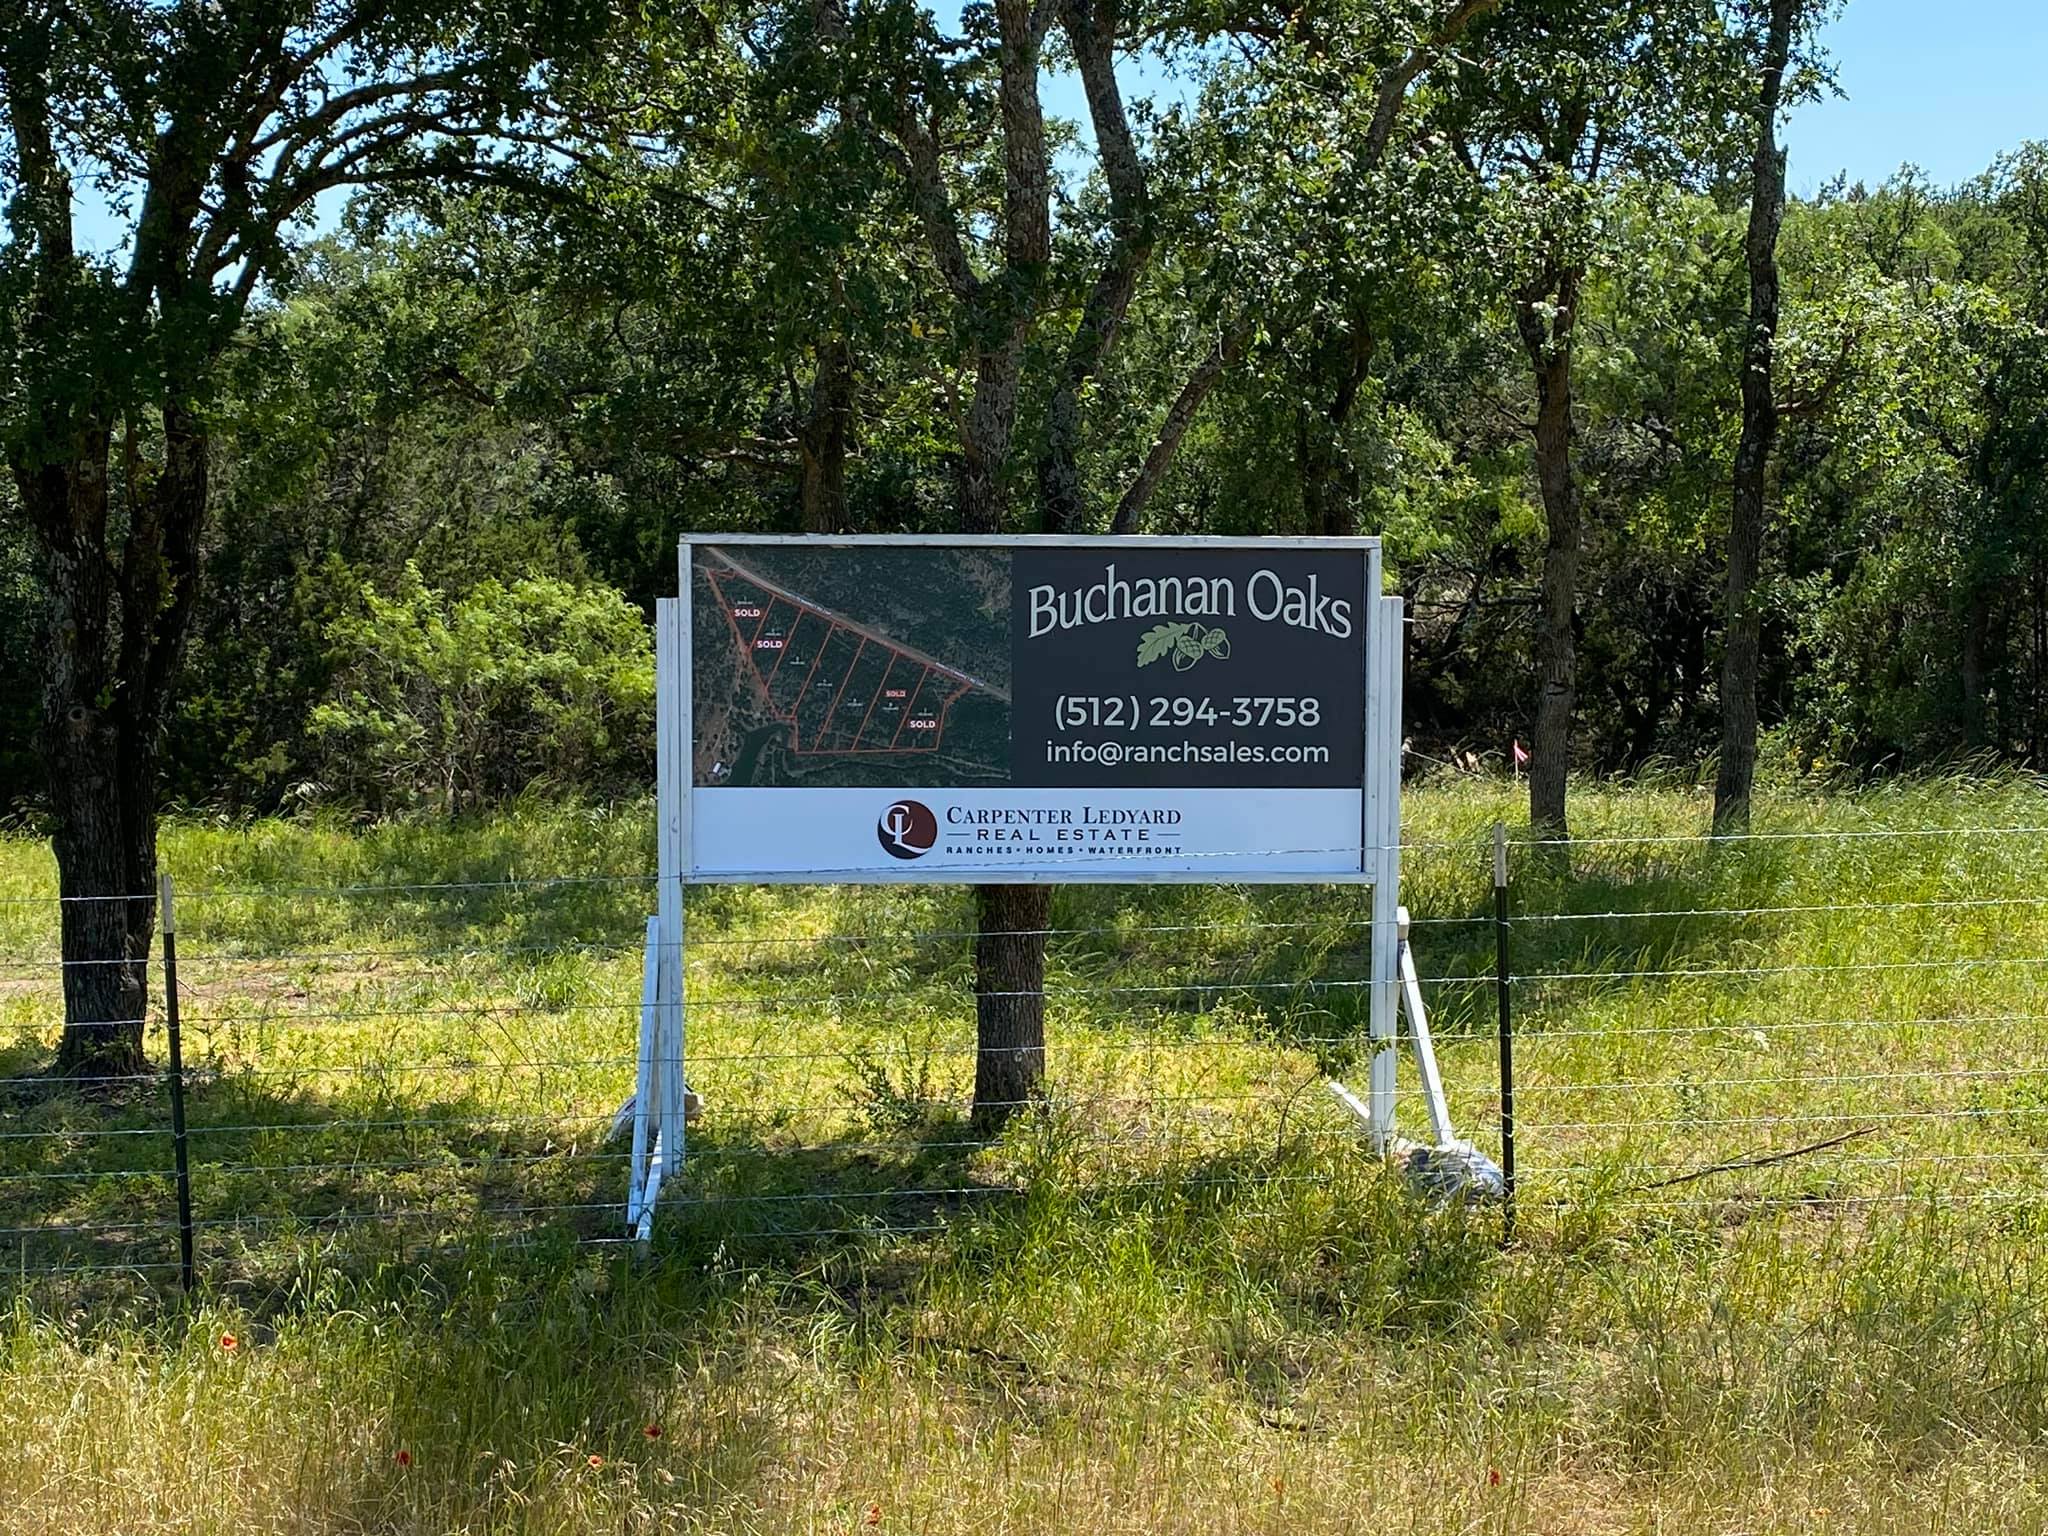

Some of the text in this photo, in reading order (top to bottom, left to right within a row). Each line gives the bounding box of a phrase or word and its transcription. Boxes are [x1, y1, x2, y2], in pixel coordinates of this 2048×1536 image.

[1028, 564, 1353, 639] Buchanan Oaks
[734, 609, 760, 618] SOLD
[757, 640, 783, 649] SOLD
[886, 690, 906, 698] SOLD
[1055, 695, 1321, 731] (512) 294-3758
[910, 720, 936, 729] SOLD
[1046, 740, 1330, 766] info@ranchsales.com
[946, 806, 1182, 825] CARPENTER LEDYARD
[977, 828, 1151, 841] REAL ESTATE
[946, 845, 1182, 855] RANCHES HOMES WATERFRONT
